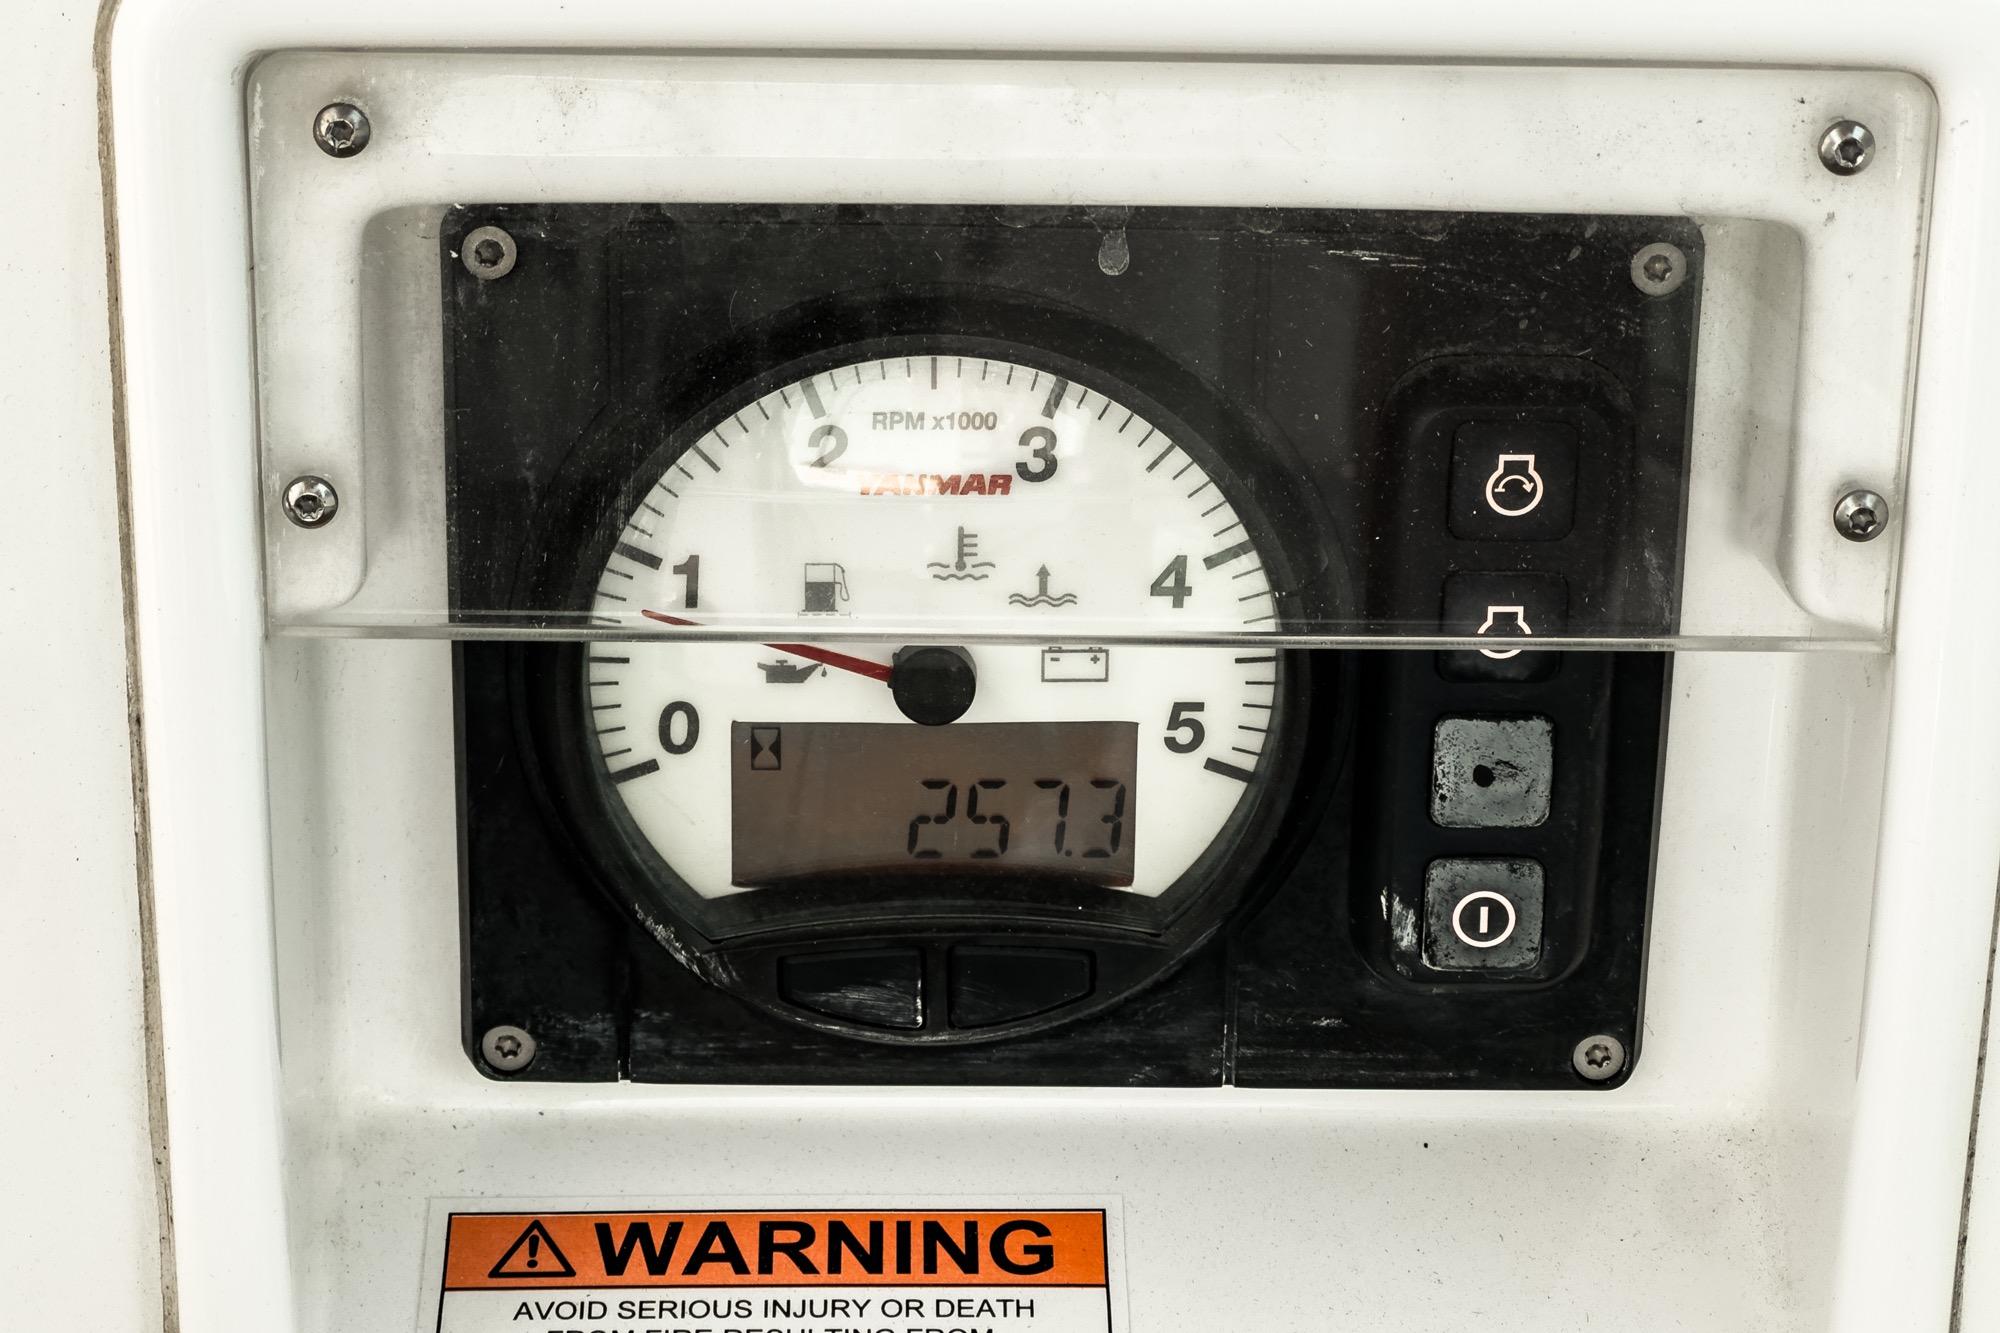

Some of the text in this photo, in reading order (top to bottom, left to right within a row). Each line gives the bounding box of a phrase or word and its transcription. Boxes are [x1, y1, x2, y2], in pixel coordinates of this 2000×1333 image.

[808, 424, 848, 468] 2
[872, 411, 998, 431] RPM x1000
[1015, 426, 1058, 483] 3
[860, 474, 1013, 496] ANMAR
[673, 554, 700, 609] 1
[1150, 554, 1192, 609] 4
[658, 701, 700, 755] 0
[1163, 701, 1206, 754] 5
[907, 778, 1127, 859] 257.3
[593, 1219, 1055, 1276] WARNING
[513, 1299, 1035, 1321] AVOID SERIOUS INJURY OR DEATH
